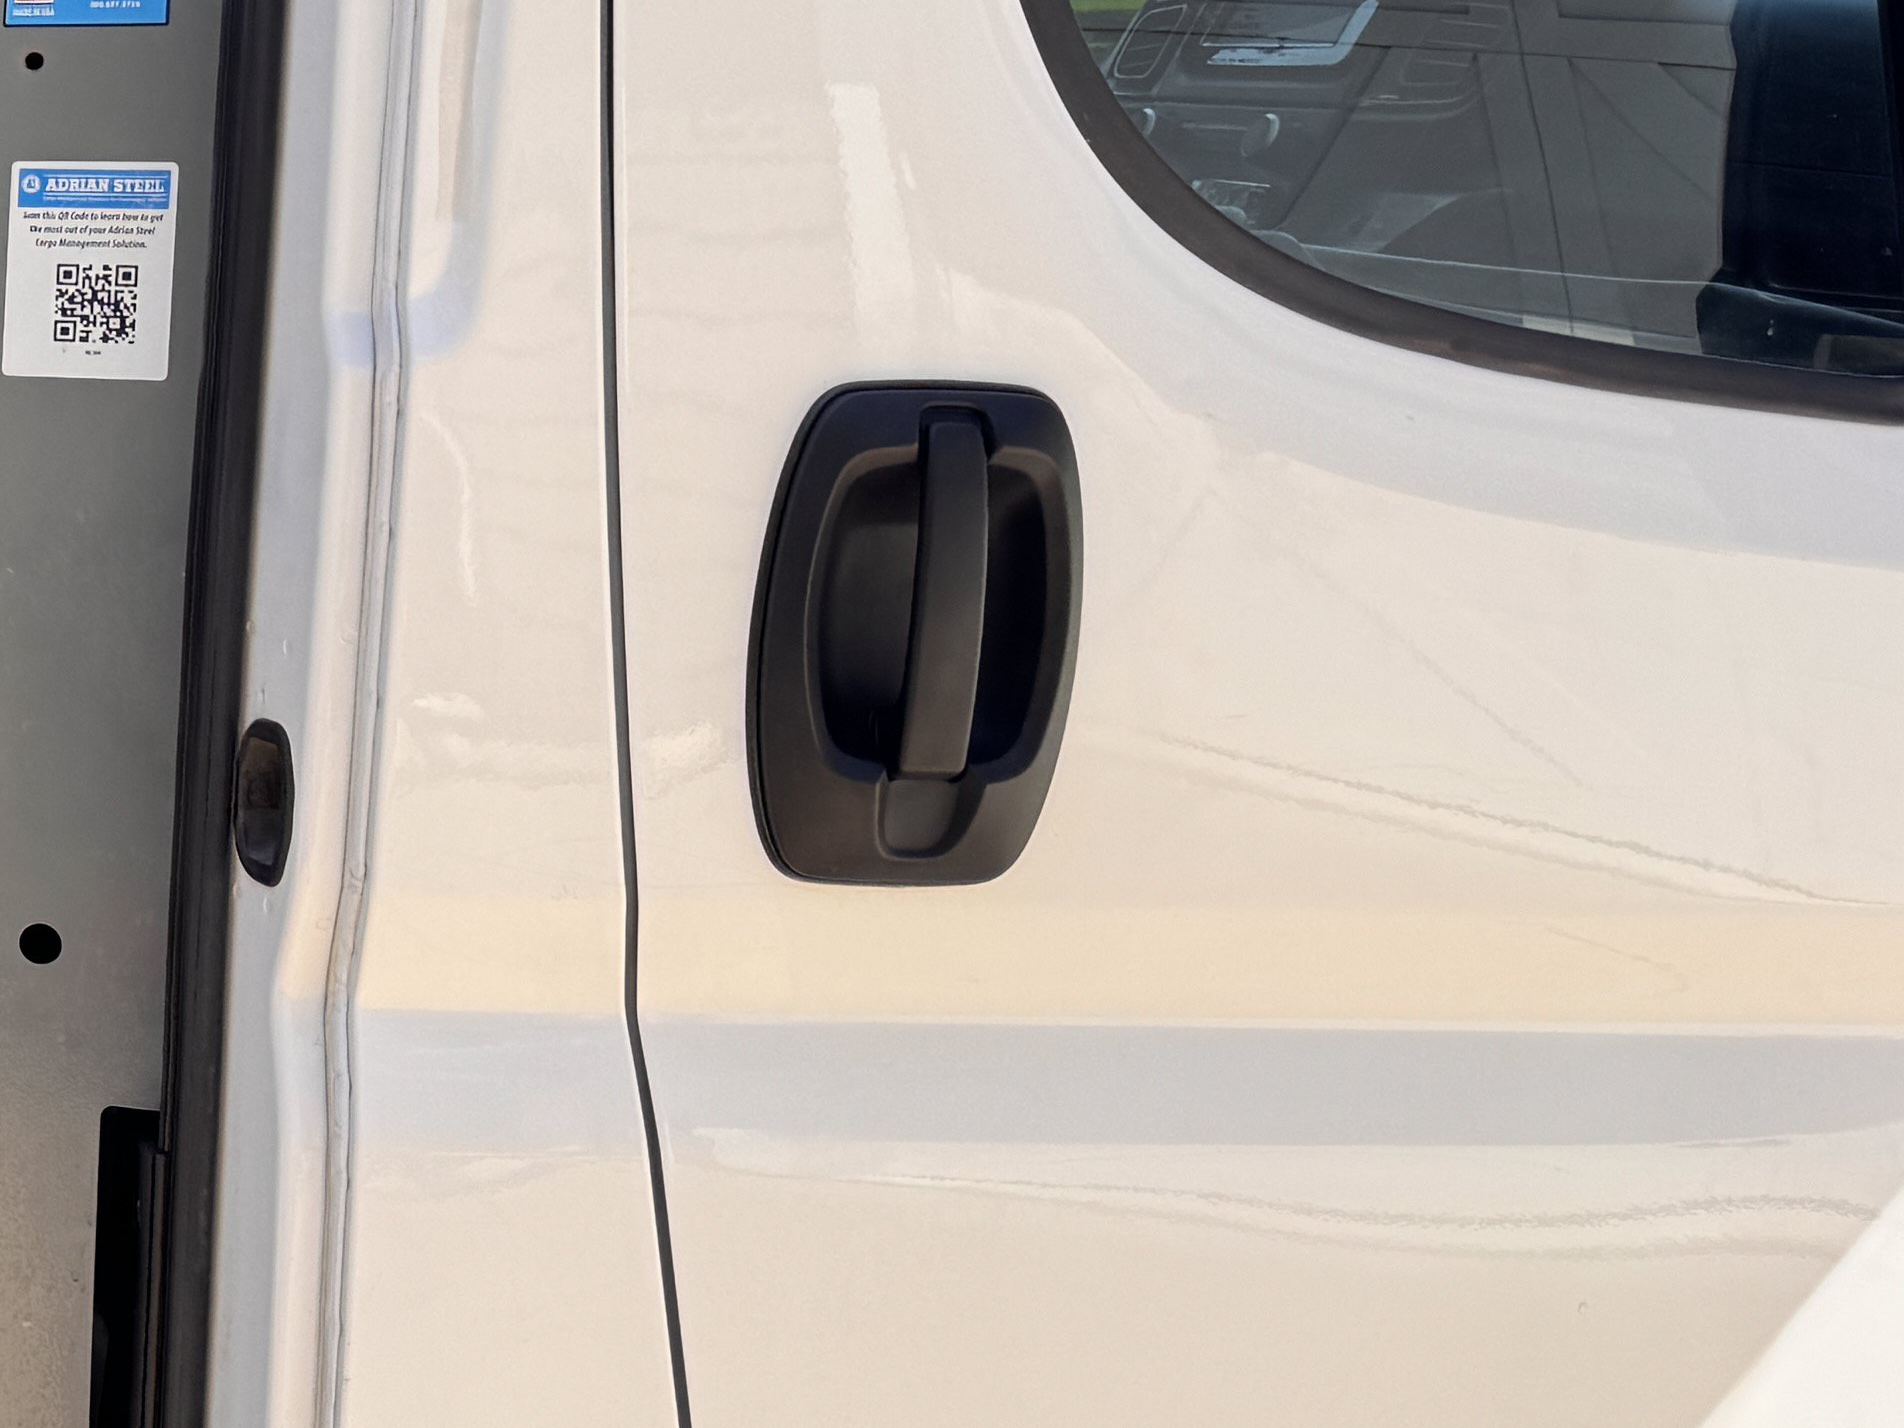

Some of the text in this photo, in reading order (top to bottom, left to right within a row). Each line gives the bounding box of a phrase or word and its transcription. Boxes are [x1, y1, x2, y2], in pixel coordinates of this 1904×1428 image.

[45, 178, 165, 193] ADRIAN STEEL
[42, 211, 56, 220] this
[58, 211, 69, 221] QR
[70, 211, 89, 220] Code
[90, 212, 99, 220] to
[100, 211, 121, 220] learn
[122, 212, 139, 221] how
[140, 213, 149, 221] to
[150, 214, 164, 223] get
[64, 226, 78, 234] out
[79, 225, 89, 234] of
[88, 227, 107, 236] your
[107, 225, 134, 234] Adrian
[136, 226, 156, 235] Steel
[35, 238, 148, 250] Cargo Management Solution.
